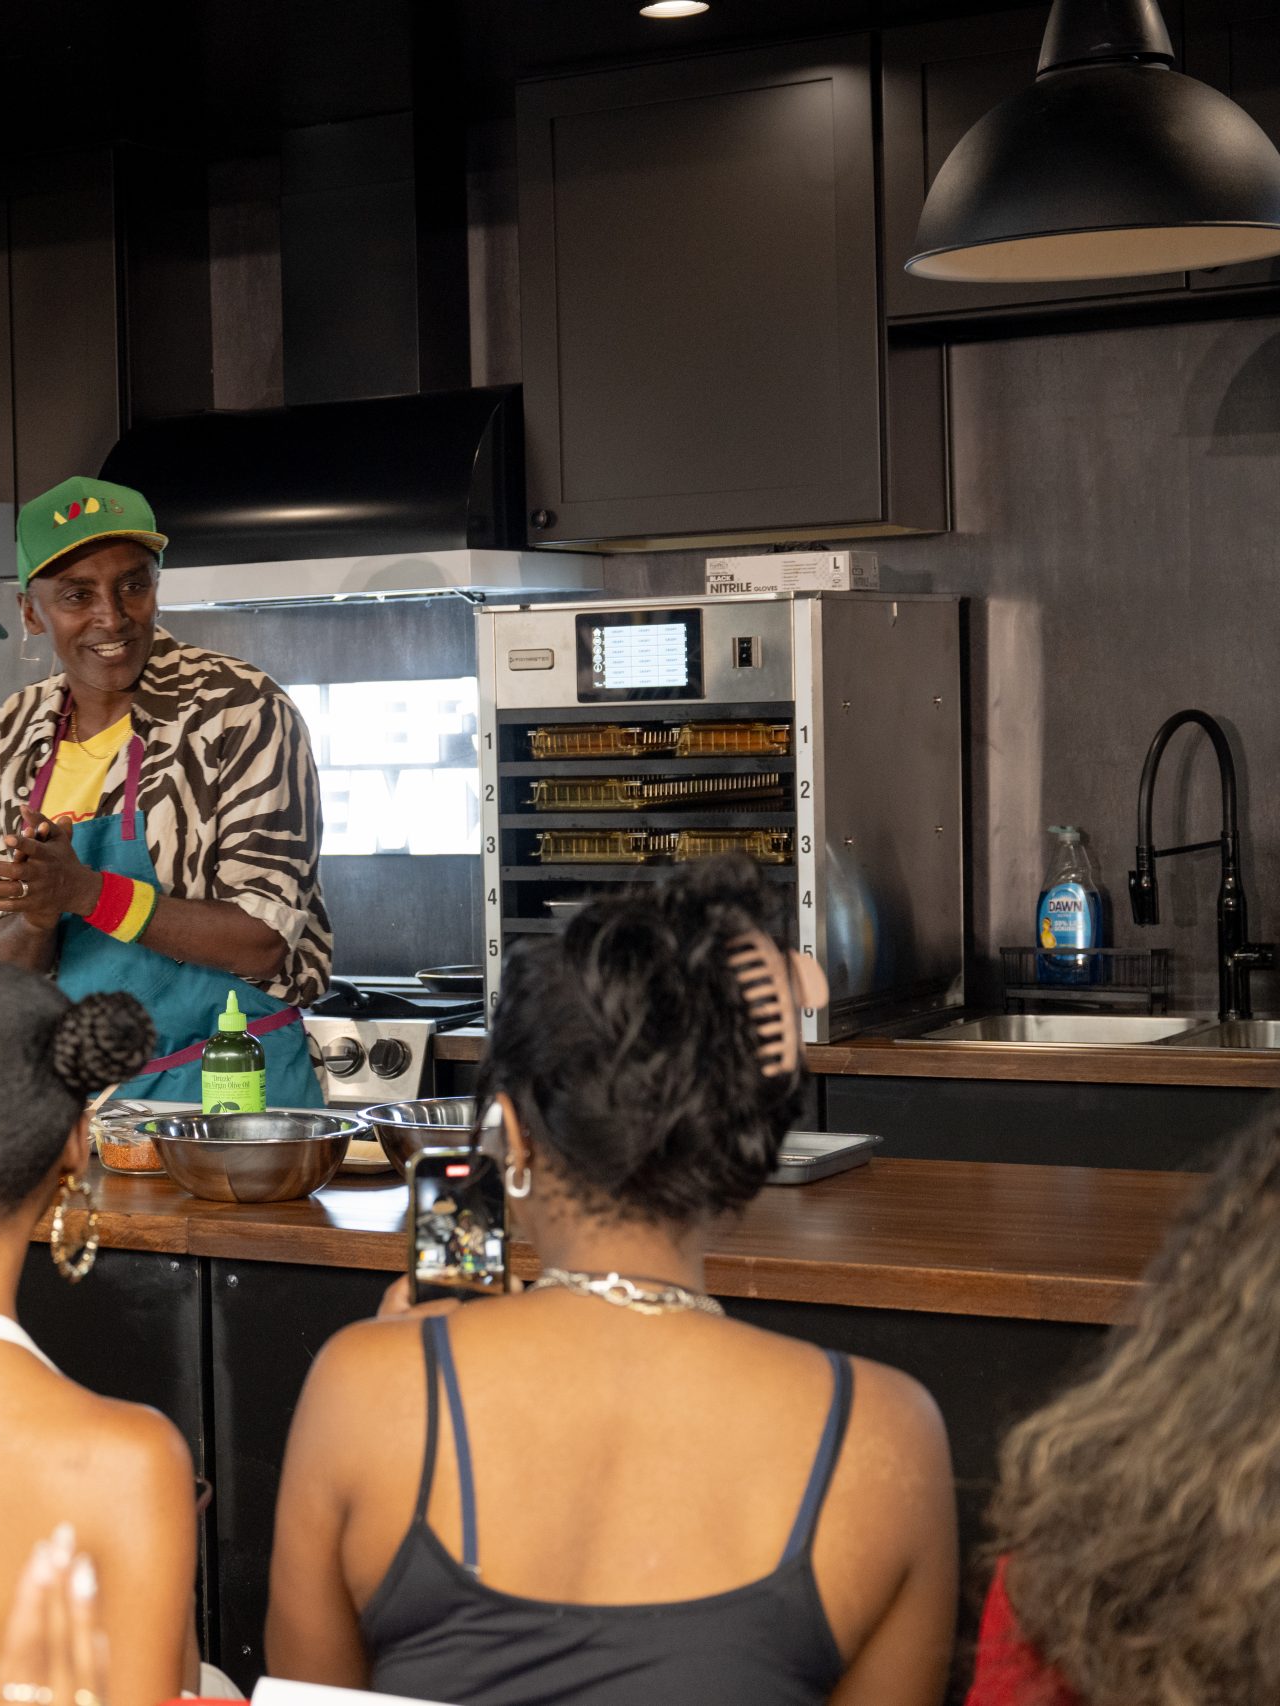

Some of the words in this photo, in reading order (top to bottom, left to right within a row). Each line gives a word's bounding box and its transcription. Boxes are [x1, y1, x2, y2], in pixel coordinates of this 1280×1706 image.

[832, 556, 840, 570] L
[709, 582, 752, 594] NITRILE
[484, 733, 493, 749] 1
[800, 725, 808, 743] 1
[485, 784, 494, 801] 2
[800, 780, 810, 798] 2
[486, 836, 496, 853] 3
[801, 835, 811, 853] 3
[487, 888, 497, 905] 4
[802, 890, 812, 908] 4
[1049, 901, 1082, 912] DAWN
[488, 939, 499, 957] 5
